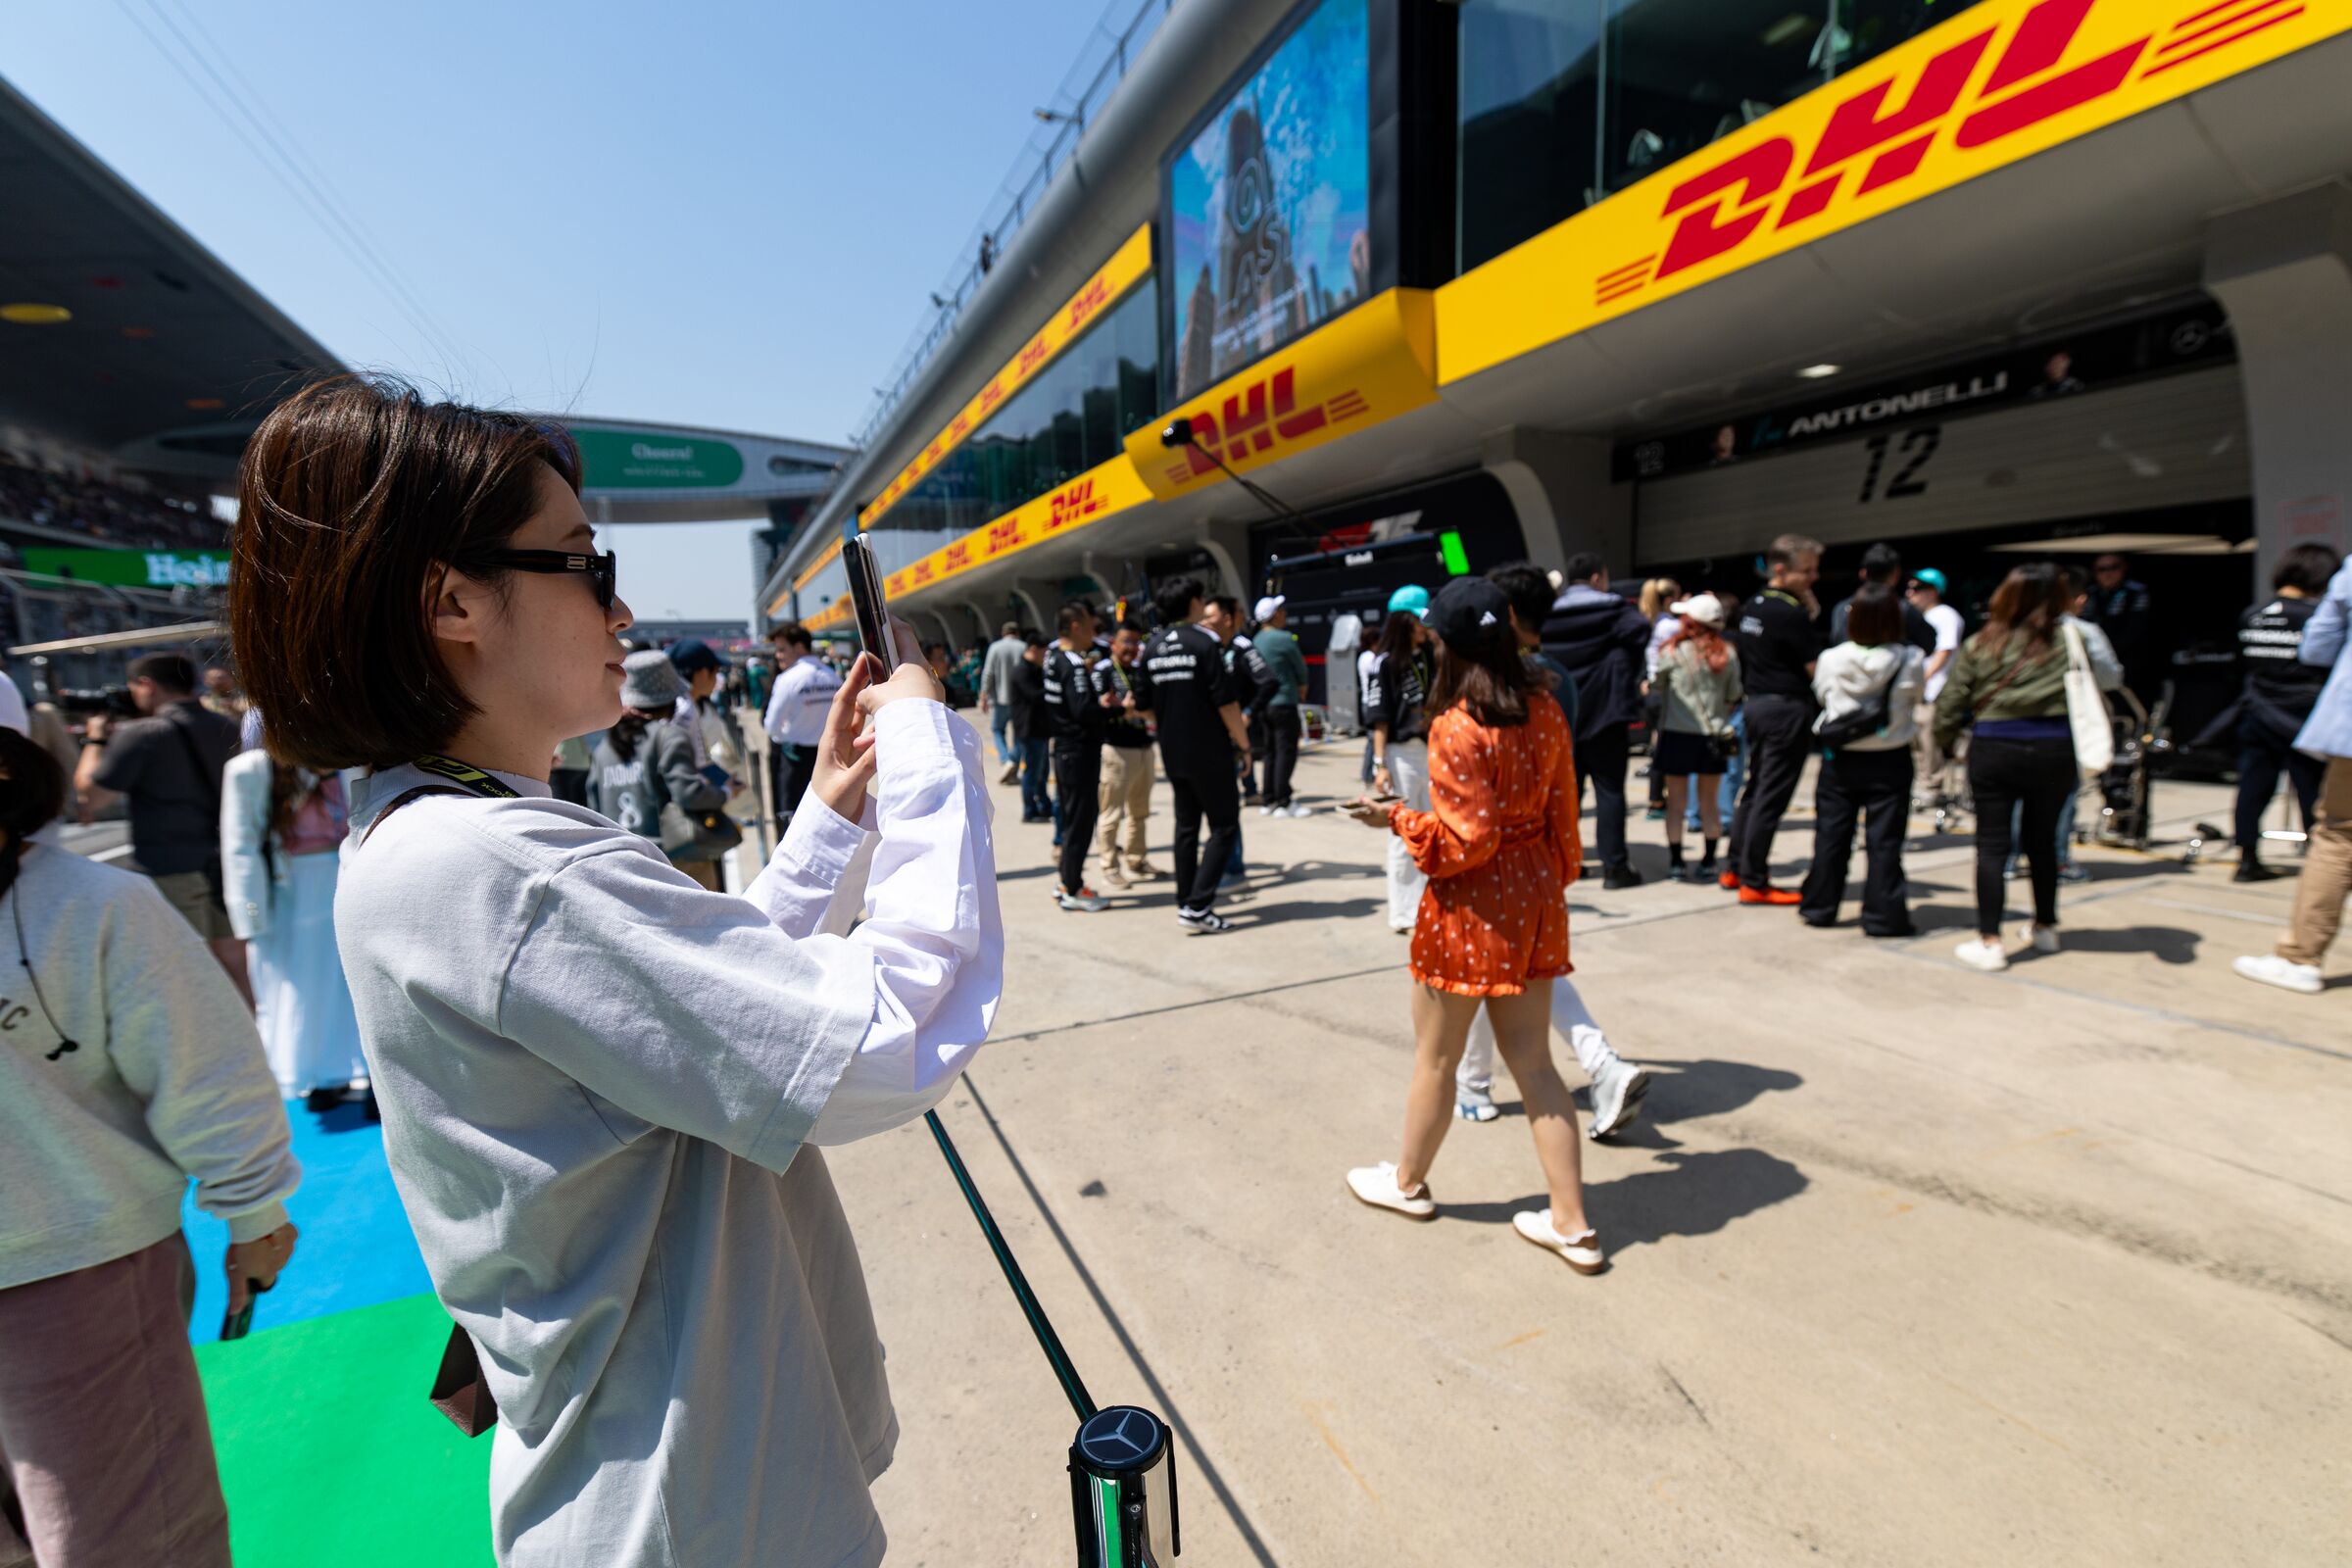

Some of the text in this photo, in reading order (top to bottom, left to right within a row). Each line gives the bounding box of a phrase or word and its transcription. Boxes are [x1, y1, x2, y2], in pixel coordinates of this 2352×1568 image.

[1655, 0, 2151, 280] DHL
[1187, 366, 1327, 476] DHL
[1788, 370, 2009, 438] ANTONELLI
[1859, 422, 1942, 504] 12
[1051, 478, 1097, 528] DHL
[989, 515, 1019, 555] DHL
[144, 553, 231, 585] Hein
[617, 791, 643, 829] 8
